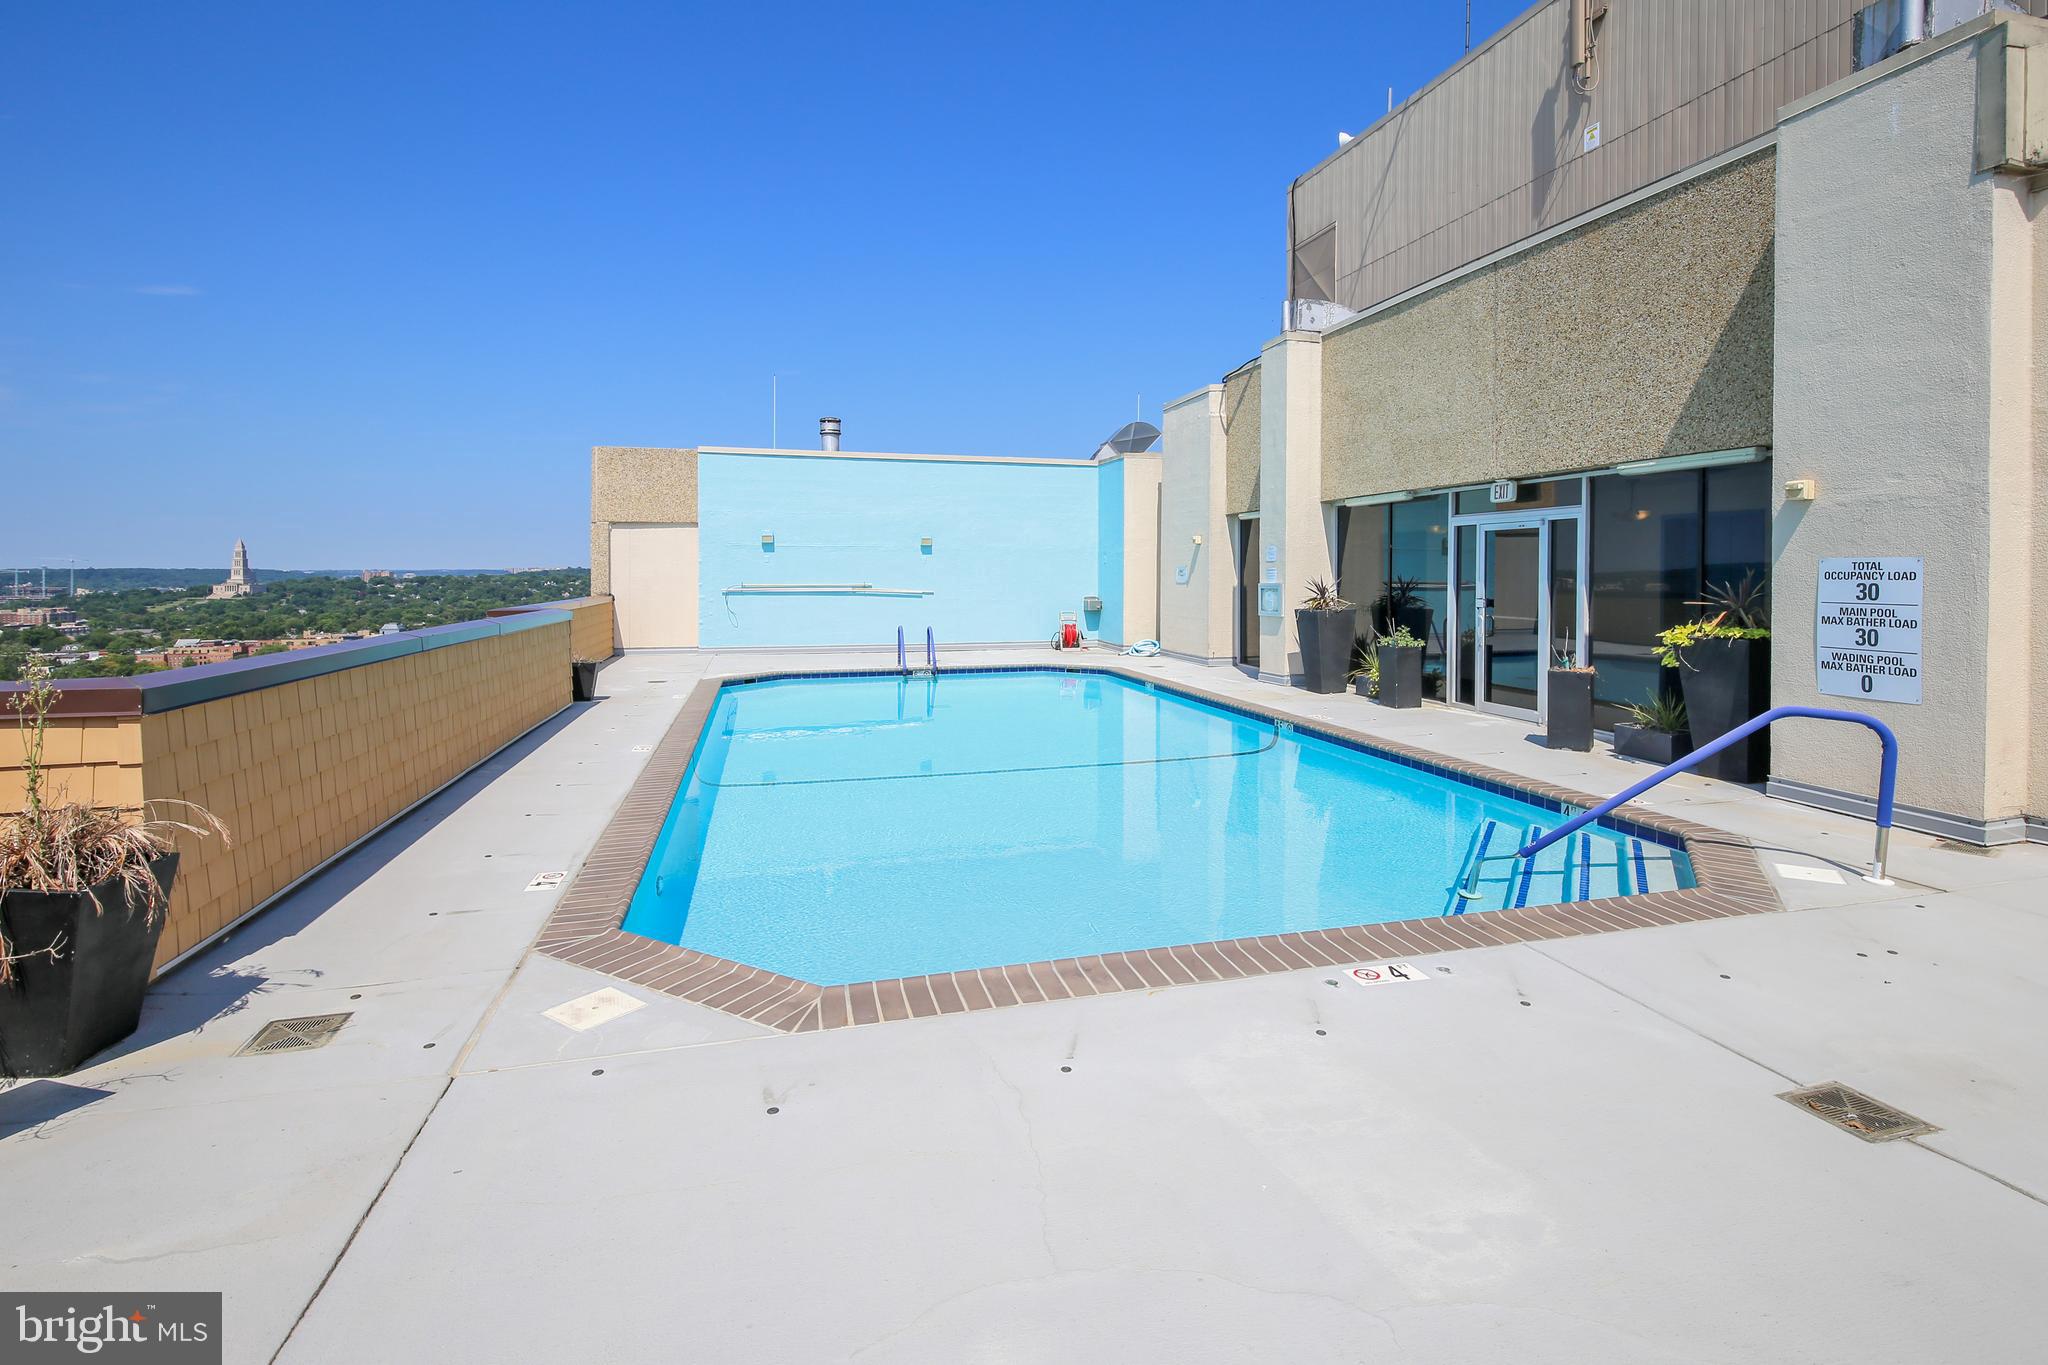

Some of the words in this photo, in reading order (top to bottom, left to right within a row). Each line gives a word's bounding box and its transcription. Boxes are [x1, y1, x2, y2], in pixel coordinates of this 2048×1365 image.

[1494, 483, 1510, 500] EXIT
[1851, 561, 1883, 571] TOTAL
[1824, 571, 1885, 581] OCCUPANCY
[1887, 571, 1917, 581] LOAD
[1855, 582, 1880, 601] 30
[1839, 607, 1868, 617] MAIN
[1870, 608, 1898, 618] POOL
[1821, 615, 1845, 626] MAX
[1846, 617, 1886, 628] BATHER
[1888, 618, 1918, 629] LOAD
[1854, 628, 1879, 647] 30
[1831, 651, 1874, 664] WADING
[1877, 655, 1905, 667] POOL
[1820, 660, 1844, 671] MAX
[1846, 662, 1886, 675] BATHER
[1888, 665, 1917, 678] LOAD
[1860, 674, 1873, 693] 0
[1388, 965, 1411, 980] 4
